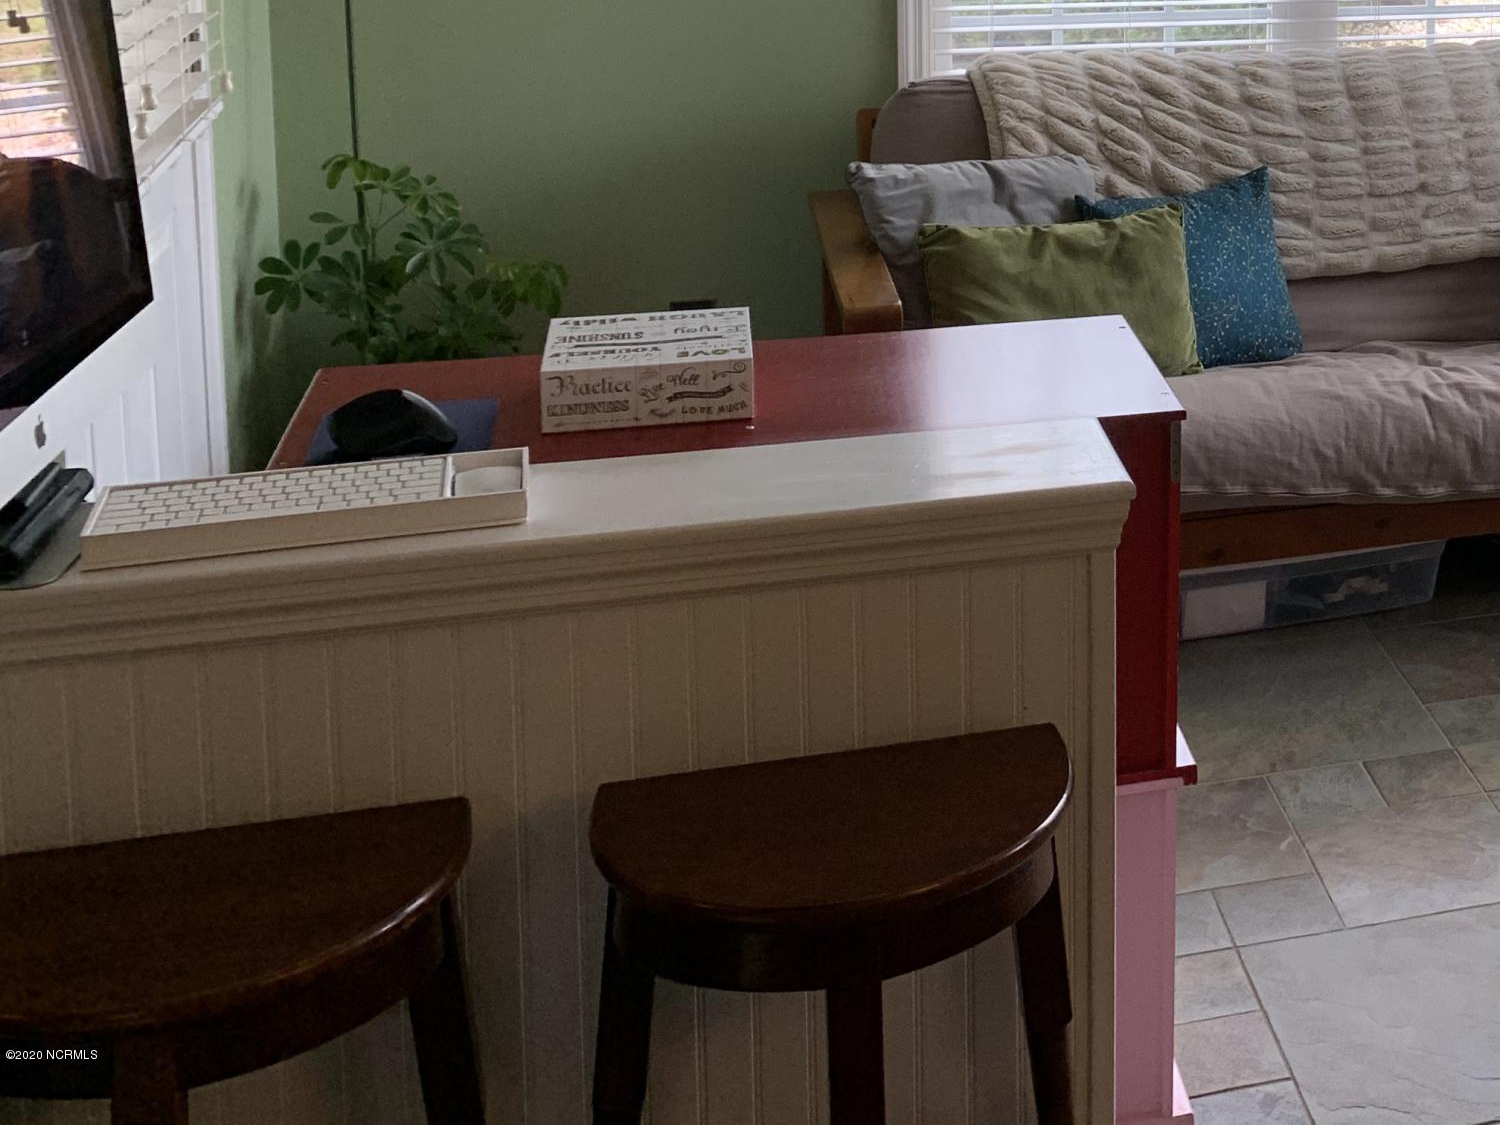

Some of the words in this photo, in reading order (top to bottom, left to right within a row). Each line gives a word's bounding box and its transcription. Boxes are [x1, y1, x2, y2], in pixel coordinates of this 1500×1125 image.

[554, 331, 644, 345] SUNSHINE
[548, 346, 662, 358] YOURSELF
[676, 346, 747, 358] LOVE
[666, 367, 701, 386] Well
[546, 375, 632, 397] Practice
[546, 399, 631, 417] KINDNESS
[681, 404, 713, 415] LOVE
[716, 399, 748, 415] MUCH
